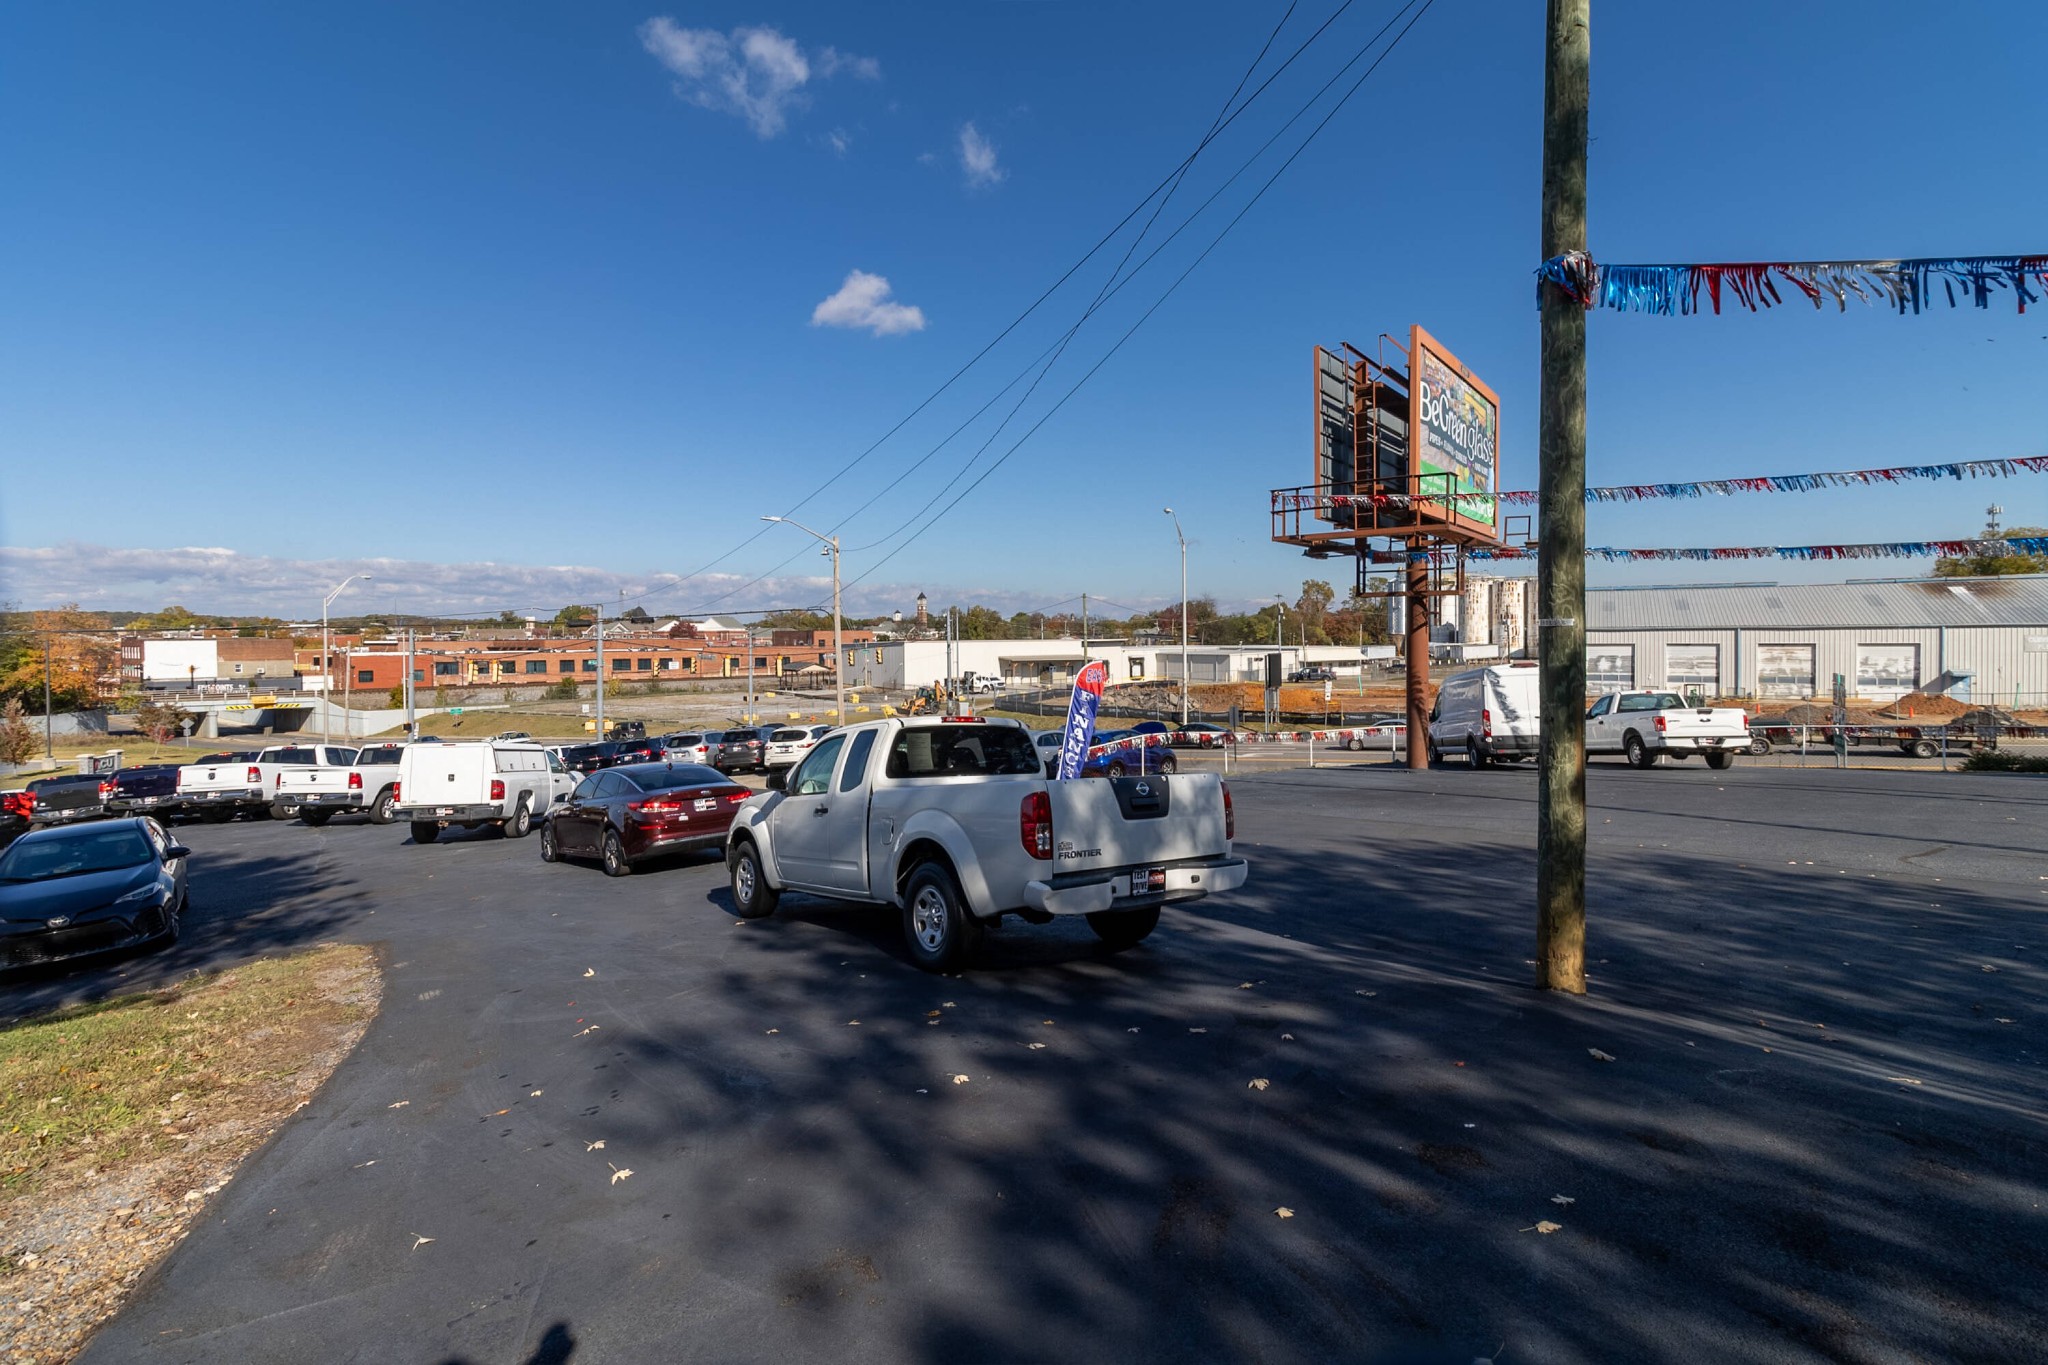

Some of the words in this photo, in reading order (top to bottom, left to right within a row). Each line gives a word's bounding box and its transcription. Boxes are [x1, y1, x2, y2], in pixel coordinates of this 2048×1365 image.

[1467, 418, 1494, 466] glass
[1058, 848, 1102, 860] FRONTIER
[1133, 871, 1146, 880] TEST
[1132, 882, 1148, 891] DRIVE
